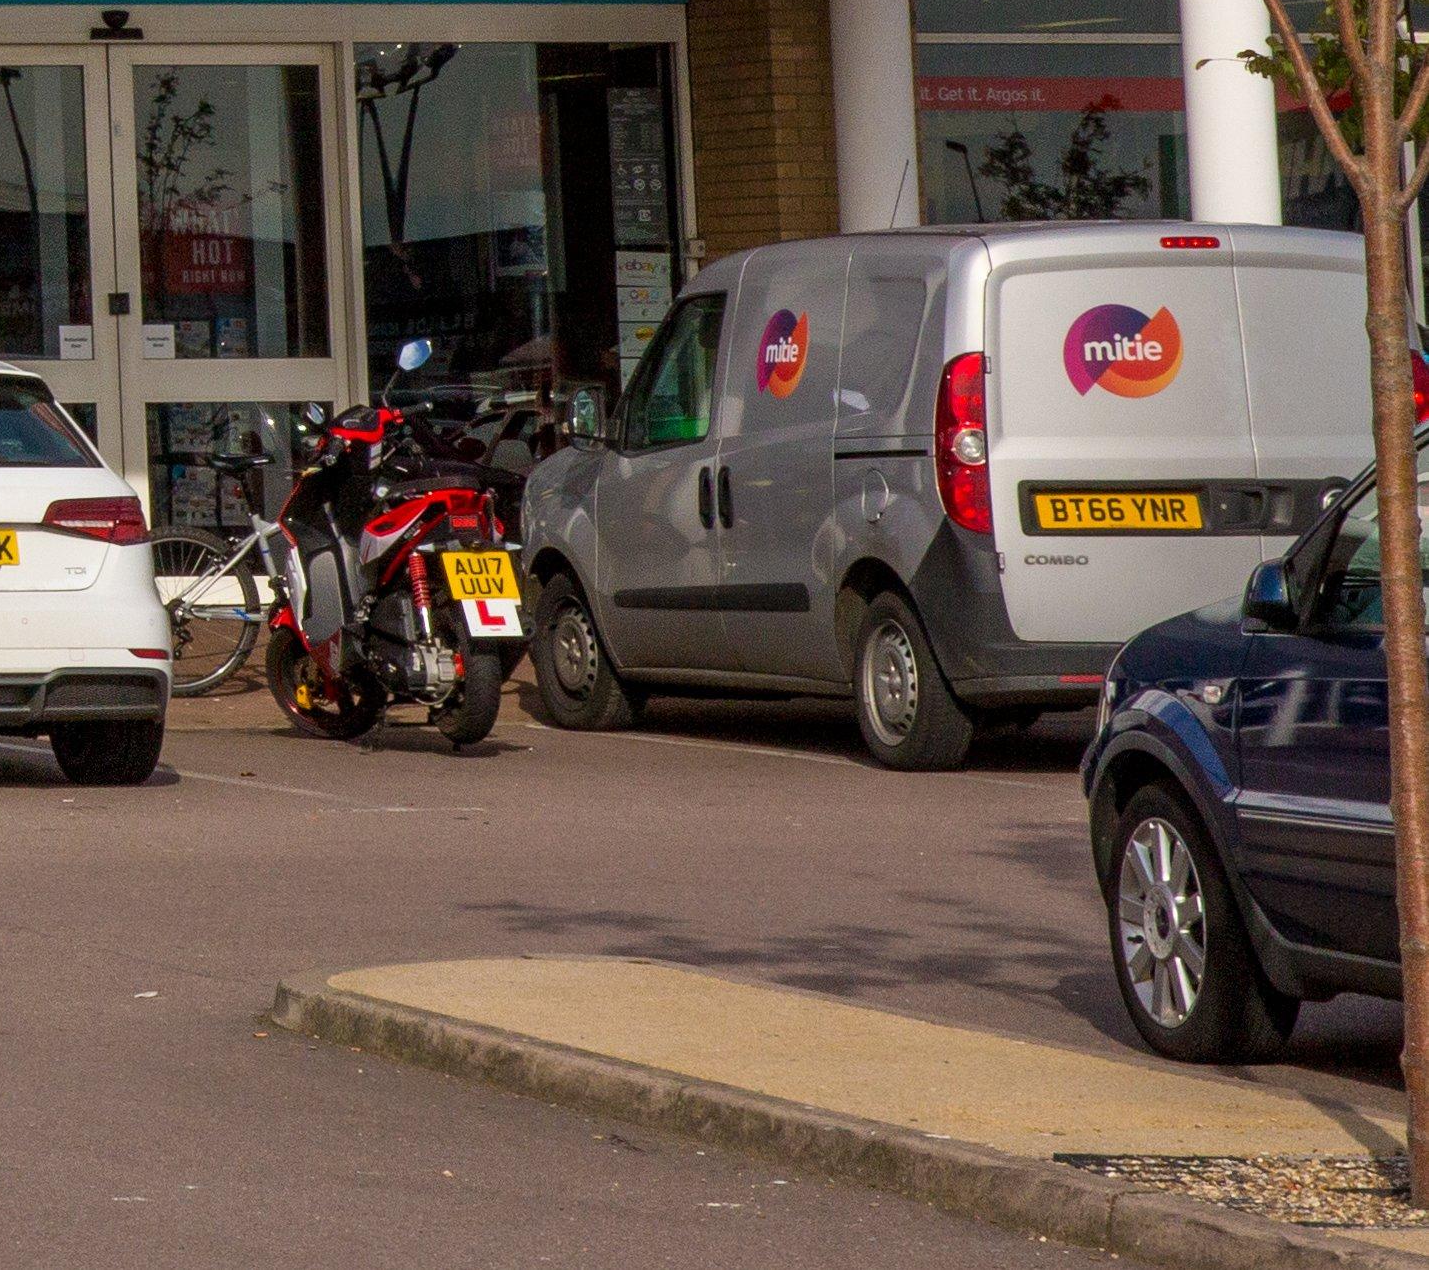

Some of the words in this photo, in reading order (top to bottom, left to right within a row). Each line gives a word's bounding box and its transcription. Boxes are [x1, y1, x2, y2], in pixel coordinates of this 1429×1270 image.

[937, 87, 963, 101] Get
[985, 87, 1028, 105] Argos
[192, 239, 233, 265] HOT
[765, 336, 799, 363] mitie
[1083, 332, 1164, 362] mitie
[1049, 497, 1124, 524] BT66
[1133, 497, 1188, 524] YNR
[455, 557, 502, 575] AU17
[1023, 555, 1090, 566] COMBO
[460, 577, 504, 596] UUV
[475, 599, 507, 626] L
